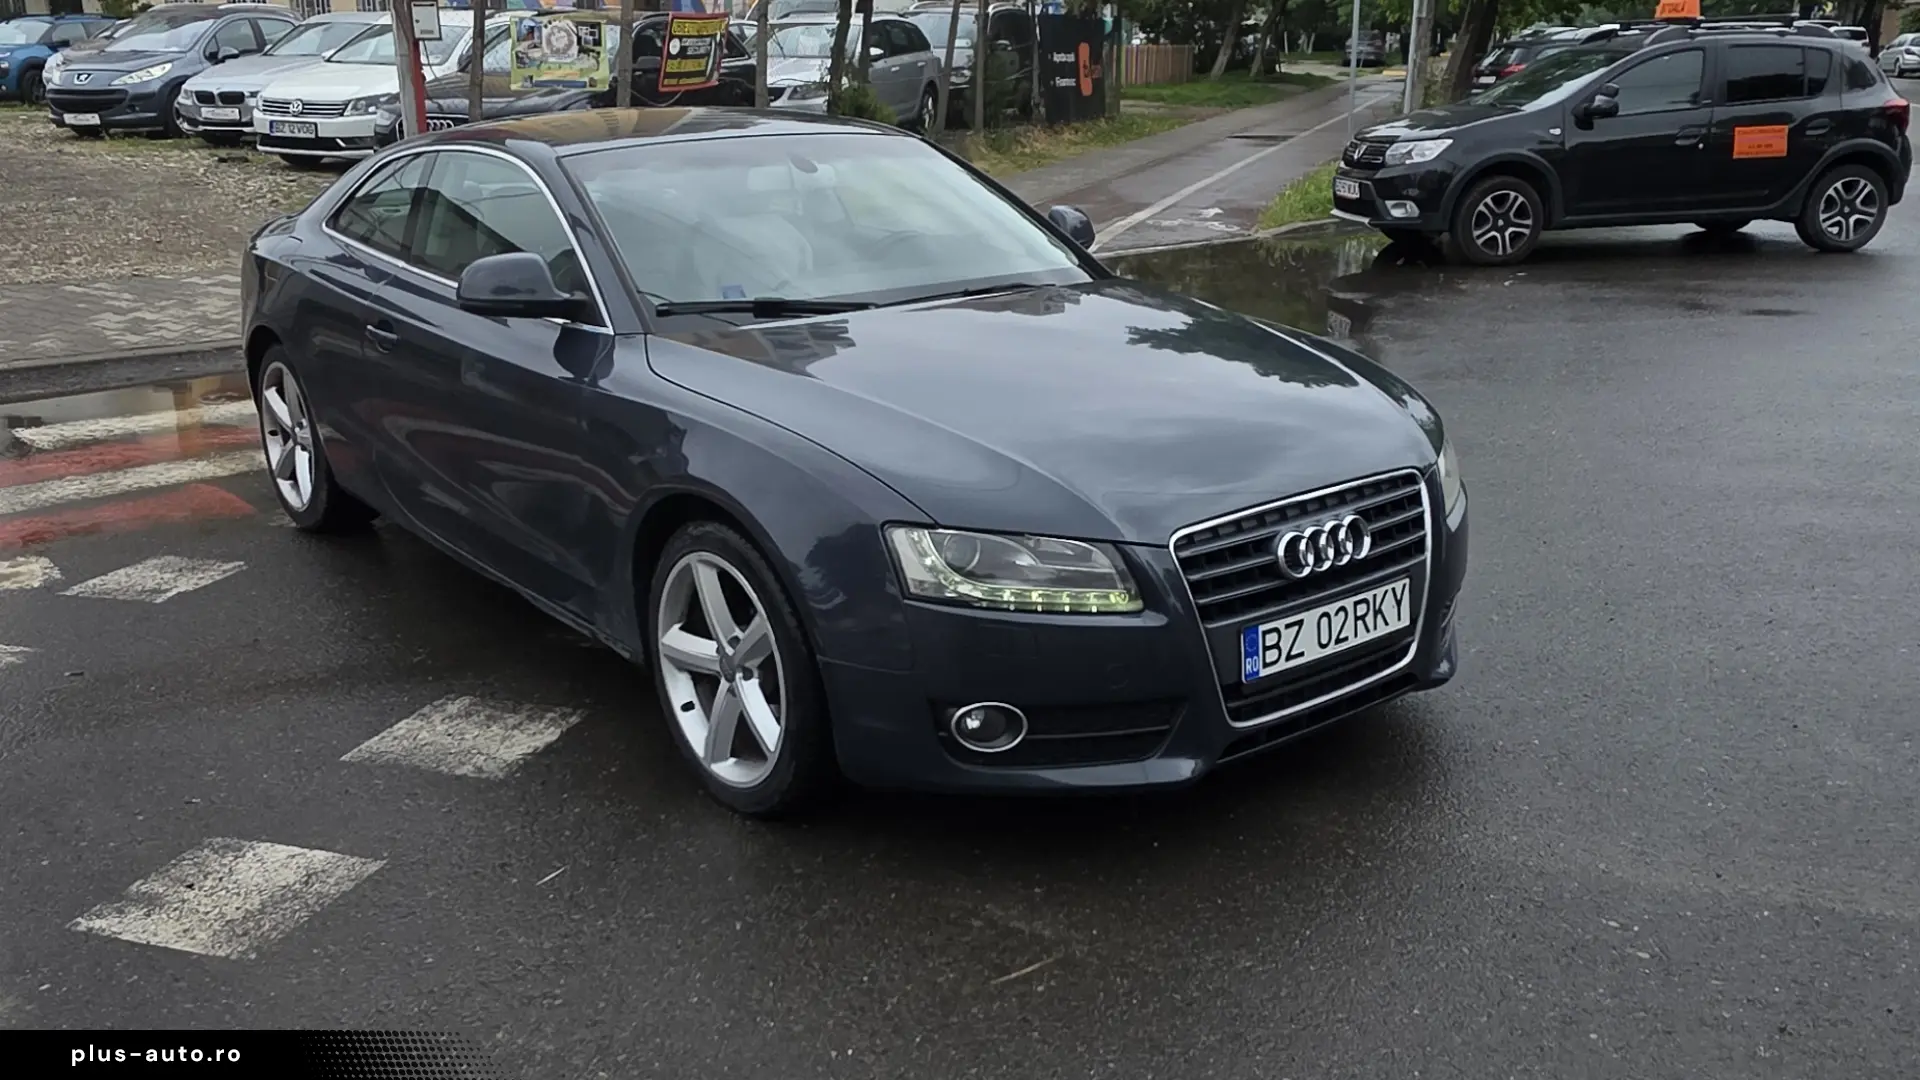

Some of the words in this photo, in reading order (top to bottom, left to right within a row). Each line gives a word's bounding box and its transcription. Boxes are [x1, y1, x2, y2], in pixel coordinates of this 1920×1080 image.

[275, 122, 286, 133] BZ
[1261, 618, 1305, 669] BZ
[1245, 656, 1259, 675] RO
